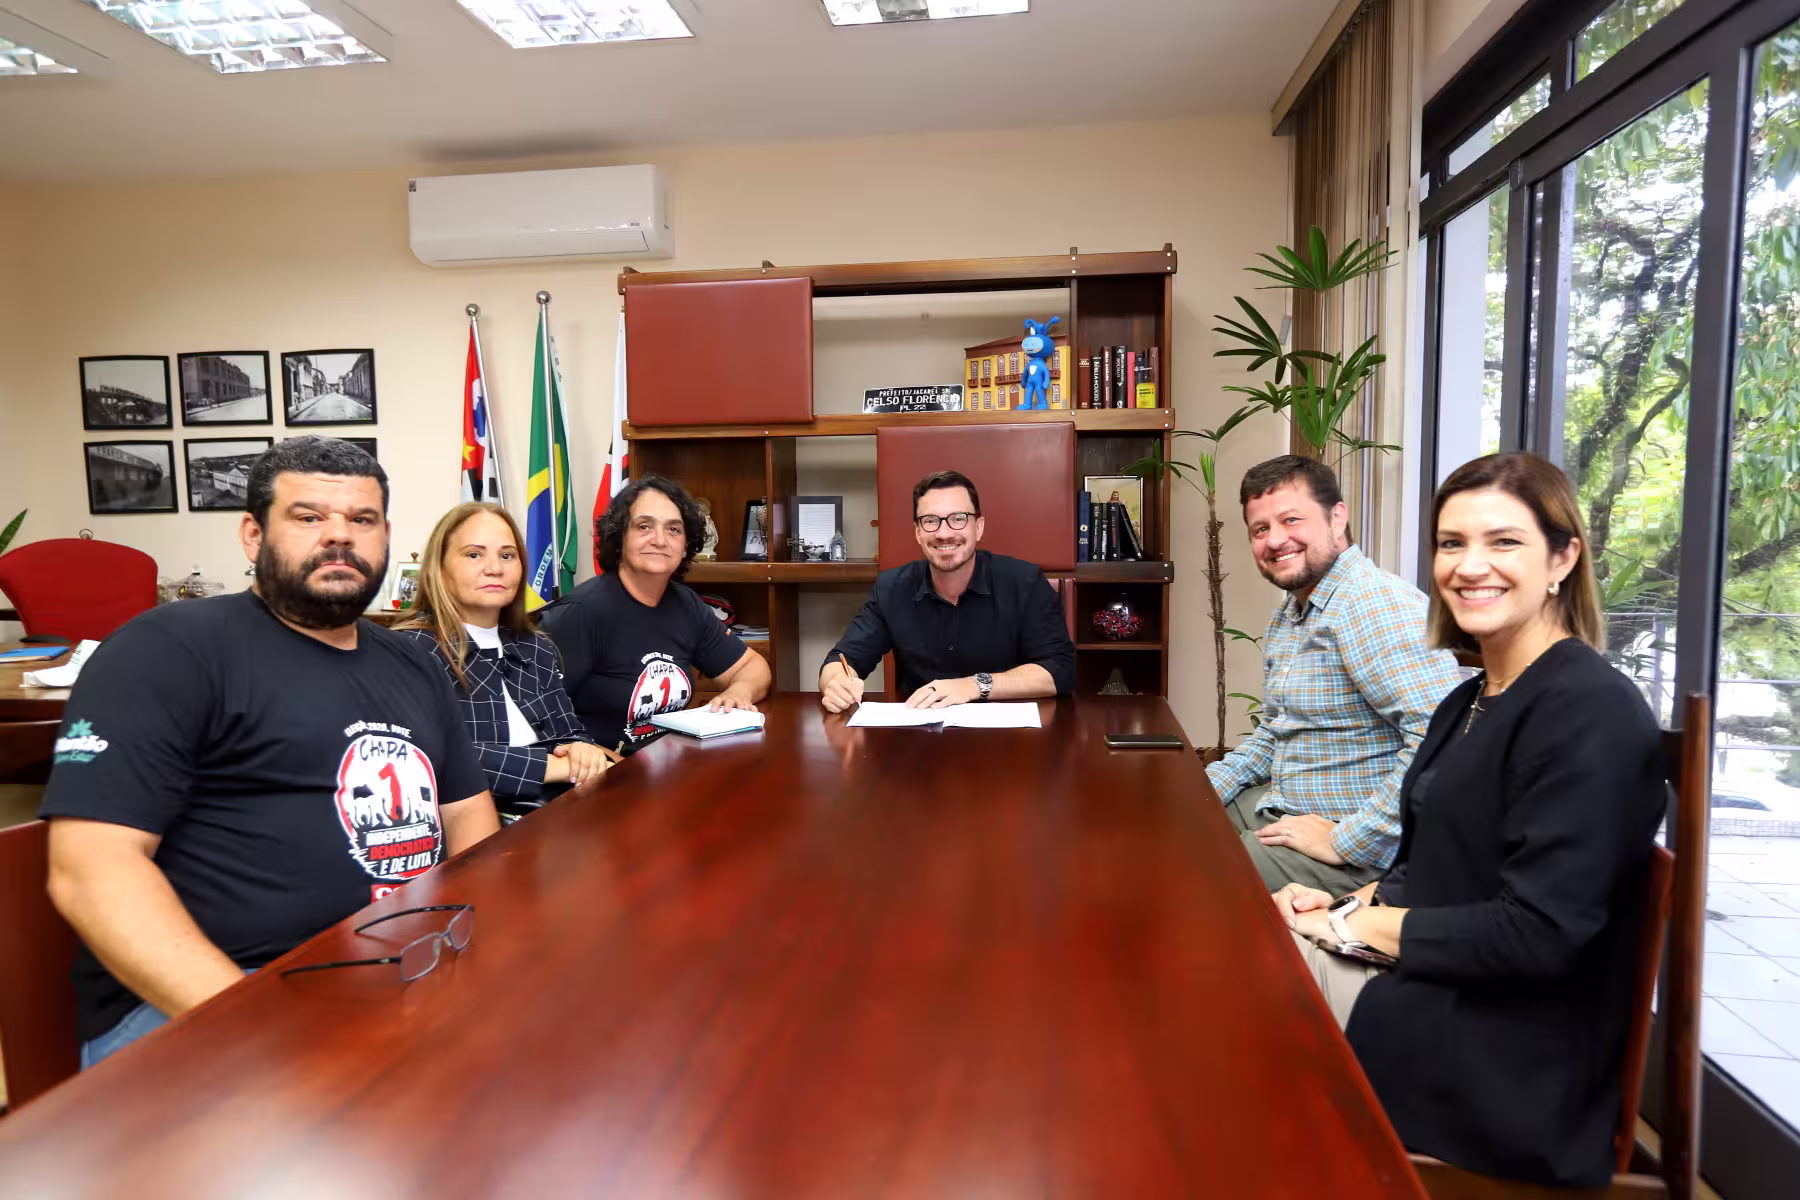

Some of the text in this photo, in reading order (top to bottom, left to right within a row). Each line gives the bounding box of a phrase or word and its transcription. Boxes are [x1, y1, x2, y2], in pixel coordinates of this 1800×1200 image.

[866, 396, 900, 406] CELSO
[534, 548, 553, 587] ORDEM
[648, 663, 675, 679] CHAPA
[658, 676, 671, 709] 1
[359, 739, 408, 761] CHAPA
[378, 762, 405, 820] 1
[380, 852, 431, 875] E DE LUTA
